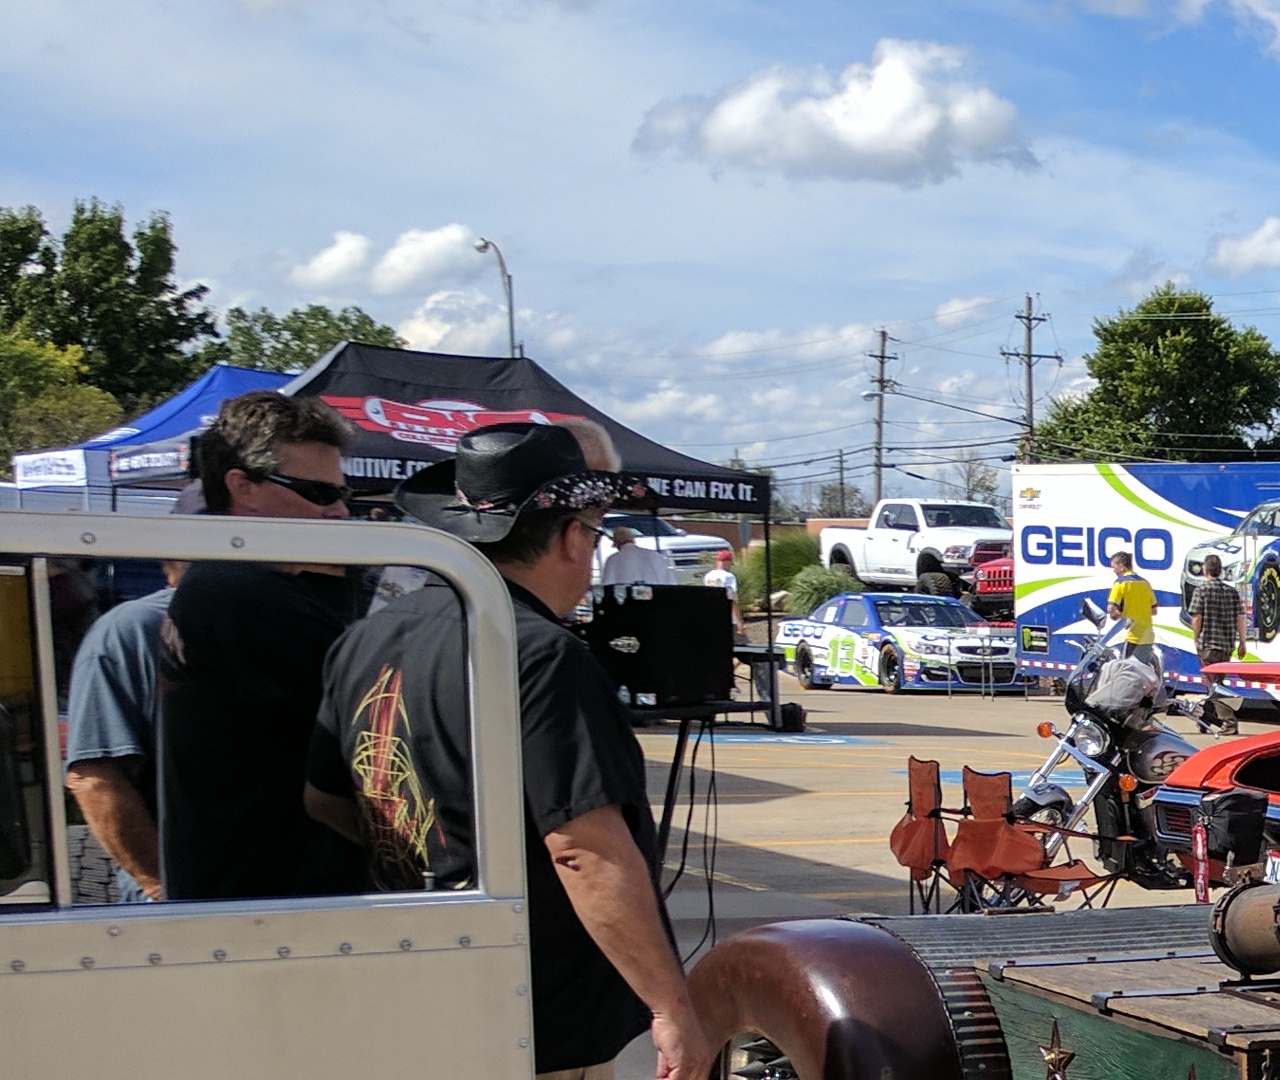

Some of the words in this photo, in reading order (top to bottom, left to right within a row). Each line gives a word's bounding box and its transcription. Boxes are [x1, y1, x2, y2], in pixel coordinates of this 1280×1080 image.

[673, 479, 706, 499] CAN
[710, 481, 735, 500] FIX
[738, 483, 758, 501] IT.
[1021, 525, 1174, 570] GEICO
[826, 635, 857, 677] 13
